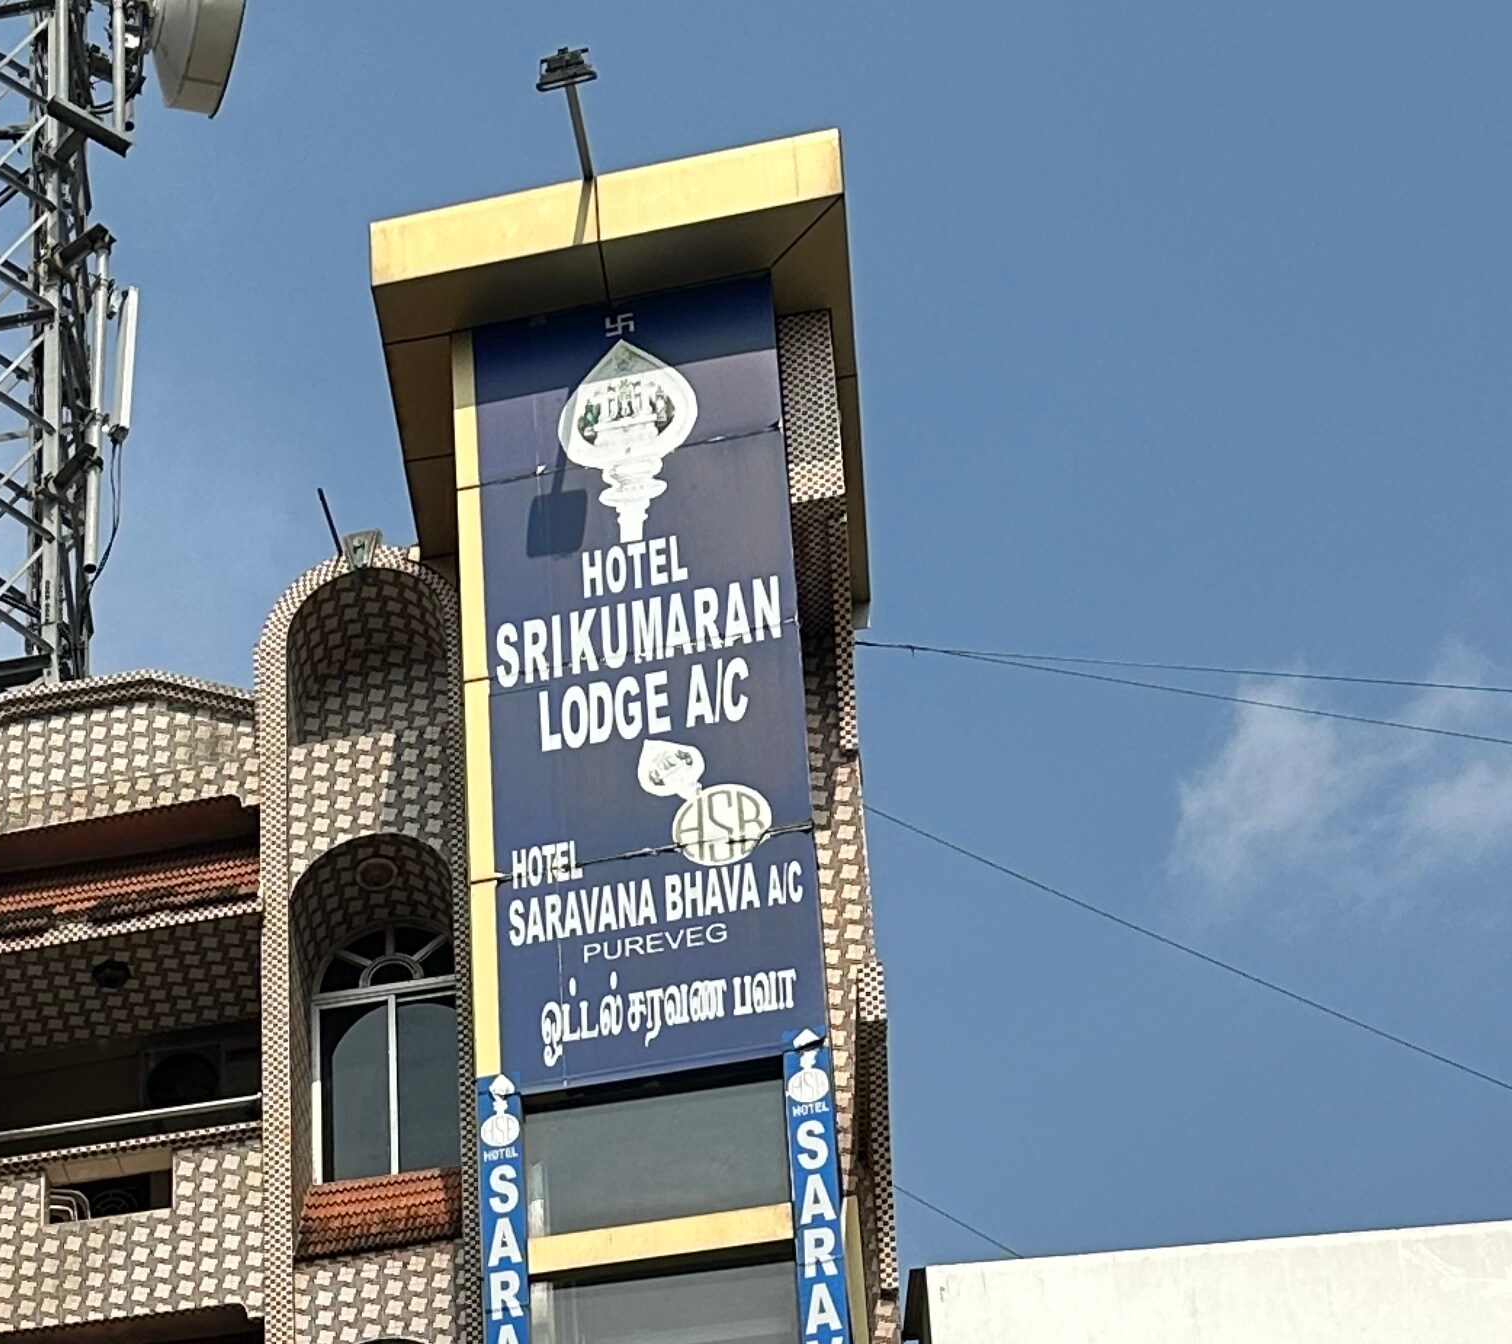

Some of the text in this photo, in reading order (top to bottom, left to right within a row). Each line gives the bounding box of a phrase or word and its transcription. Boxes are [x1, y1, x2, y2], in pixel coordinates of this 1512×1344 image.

[582, 535, 688, 599] HOTEL
[539, 658, 749, 751] LODGE A/C
[512, 841, 583, 889] HOTEL
[509, 861, 804, 947] SARAVANA BHAVA A/C
[628, 977, 726, 1047] சரவண
[733, 968, 796, 1017] பவா
[792, 1102, 830, 1117] HOTEL
[483, 1147, 519, 1163] HOTEL
